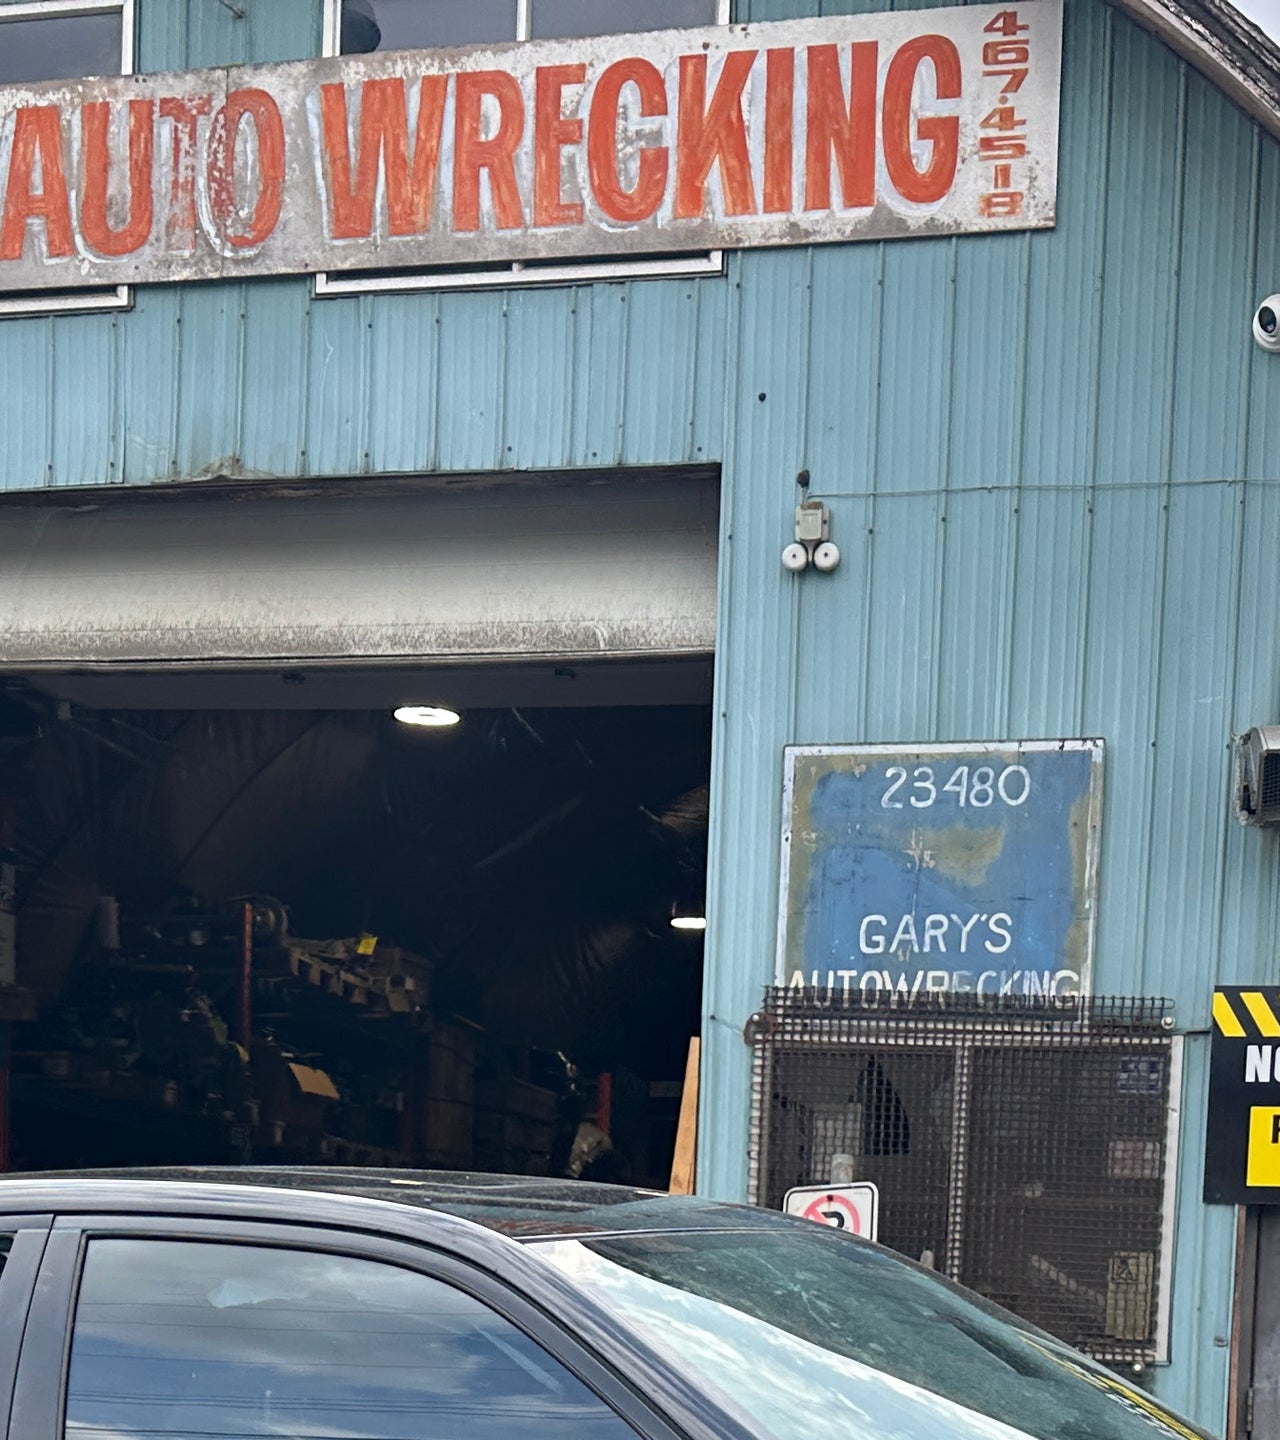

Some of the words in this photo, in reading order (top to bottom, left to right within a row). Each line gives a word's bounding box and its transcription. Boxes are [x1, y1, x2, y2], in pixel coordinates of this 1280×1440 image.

[321, 34, 963, 240] WRECKING
[880, 764, 1032, 809] 23480
[858, 912, 1014, 954] GARY'S
